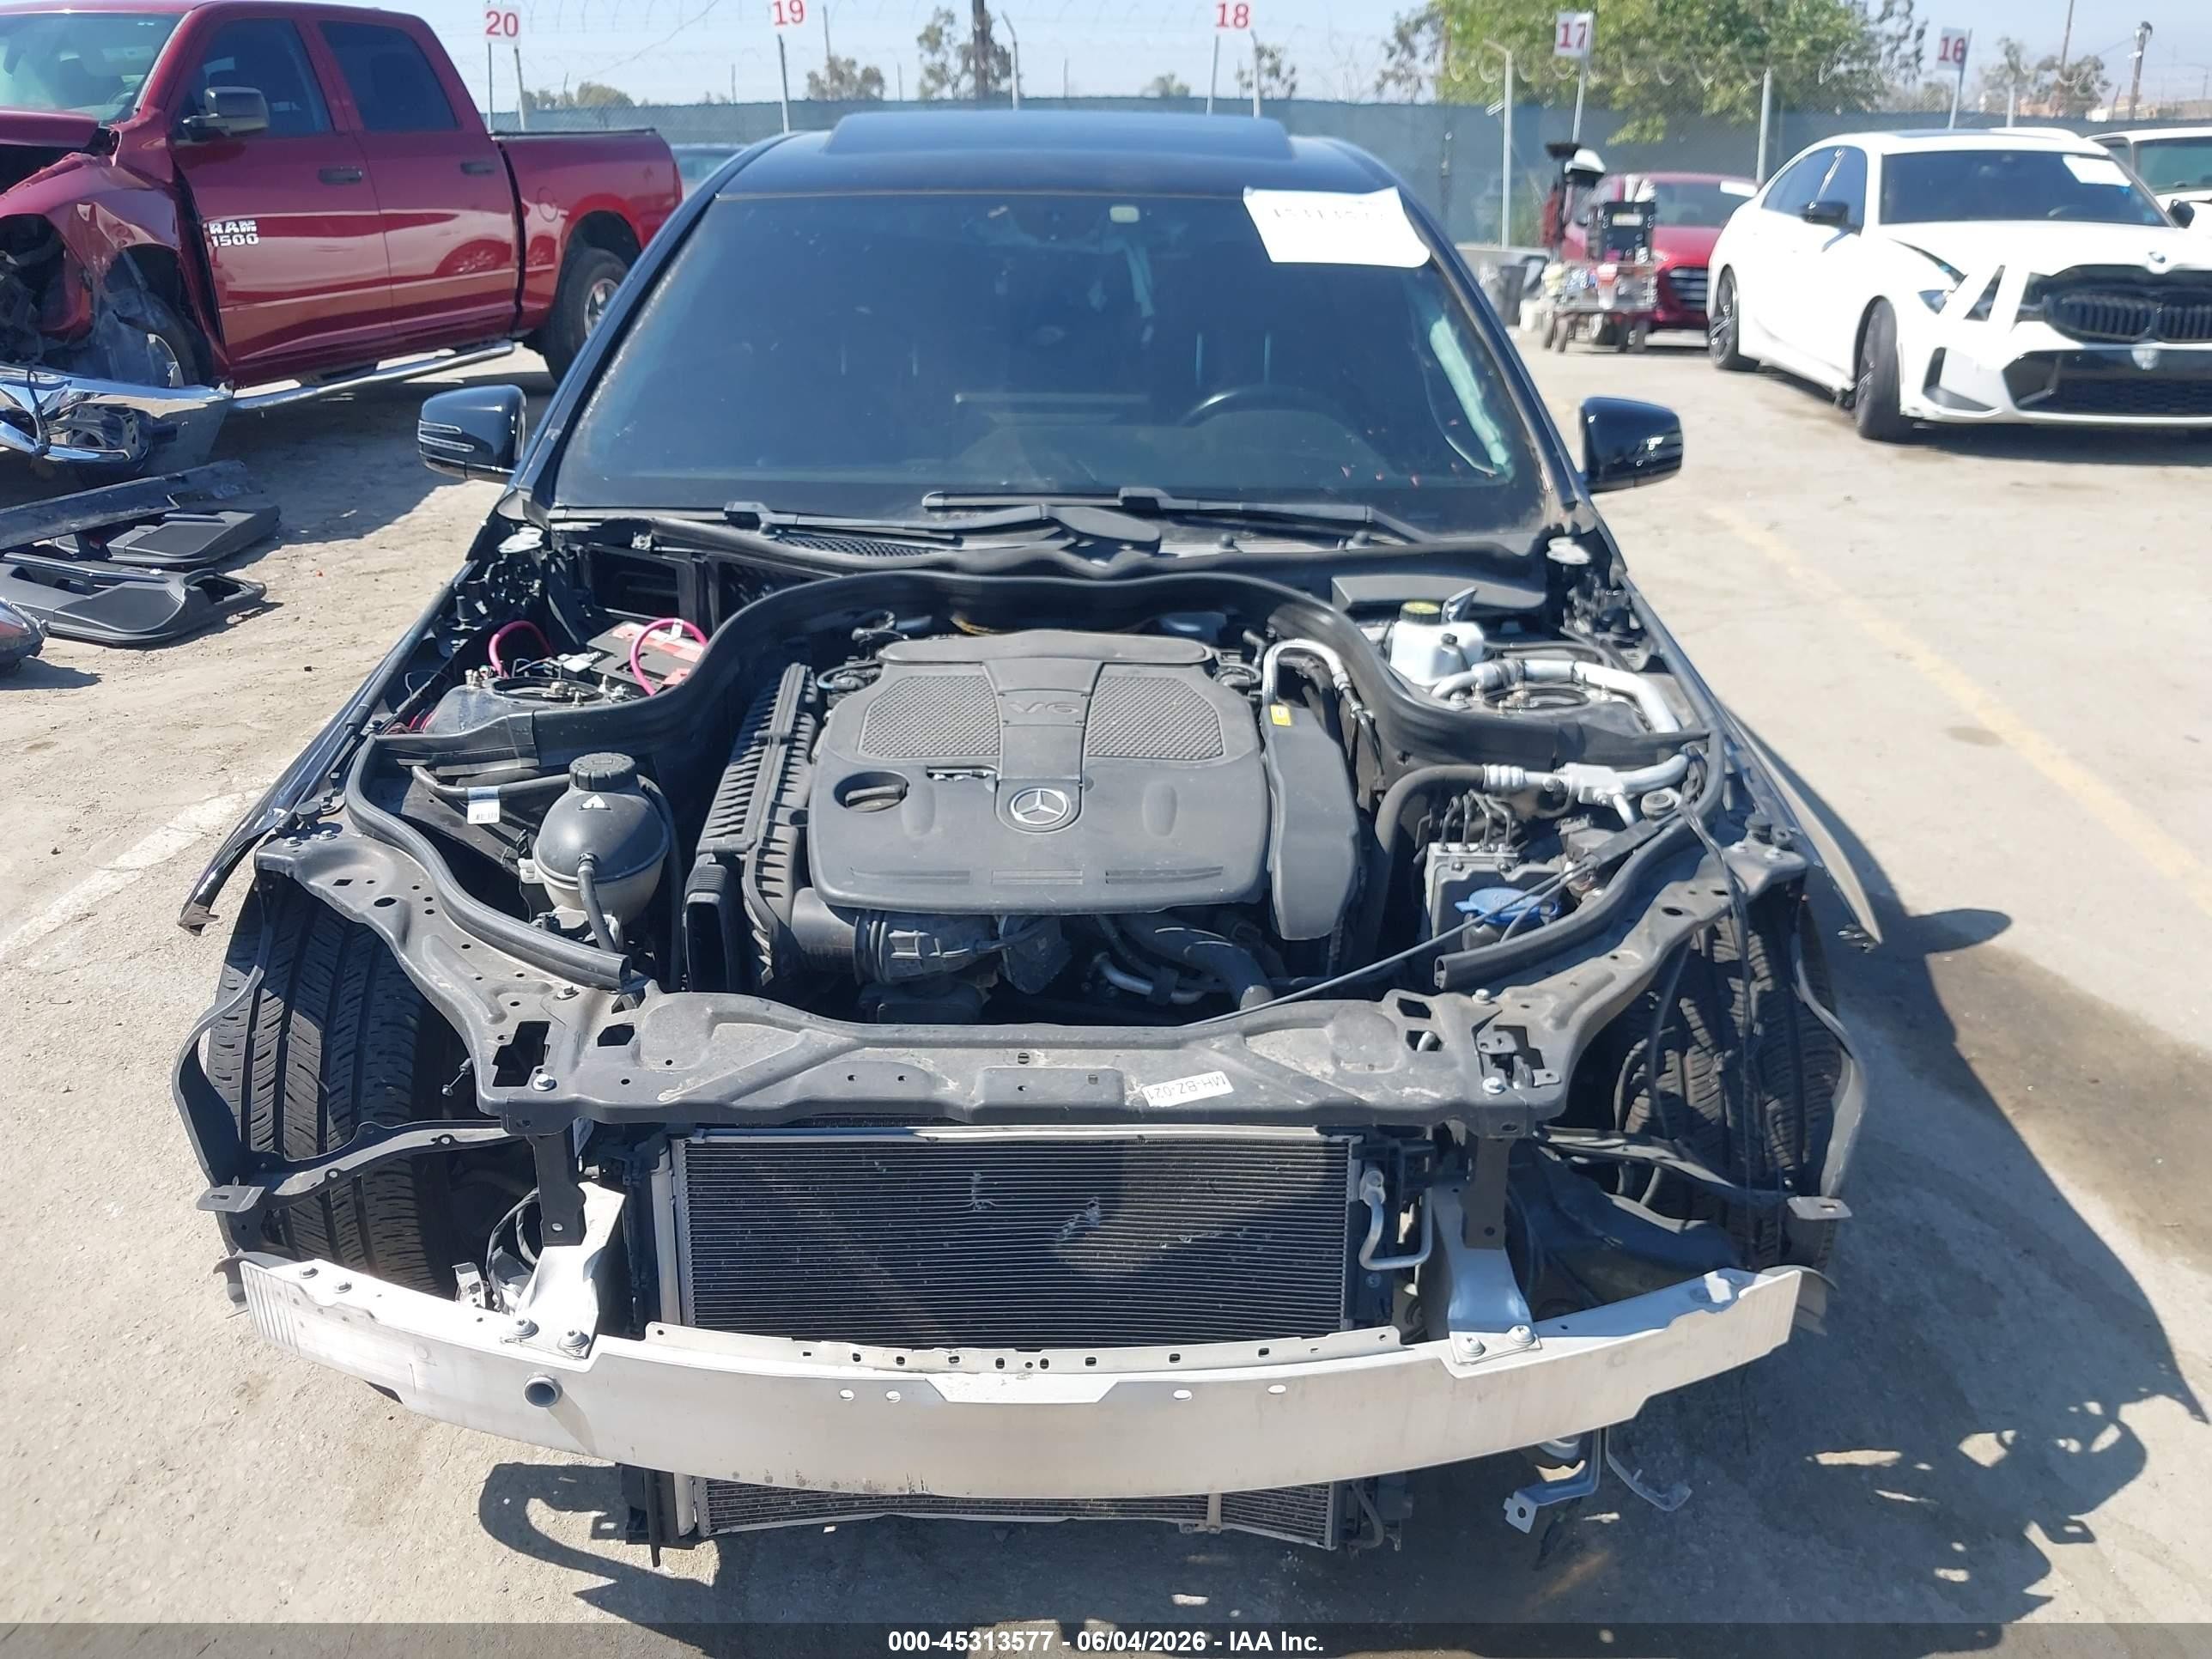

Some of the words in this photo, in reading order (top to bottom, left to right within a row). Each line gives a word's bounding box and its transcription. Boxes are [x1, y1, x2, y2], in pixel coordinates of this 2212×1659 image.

[486, 10, 519, 38] 20
[772, 0, 804, 26] 19
[1215, 3, 1249, 29] 18
[1559, 21, 1587, 49] 17
[208, 220, 258, 234] RAM
[210, 233, 259, 247] 1500
[1008, 700, 1079, 714] V6
